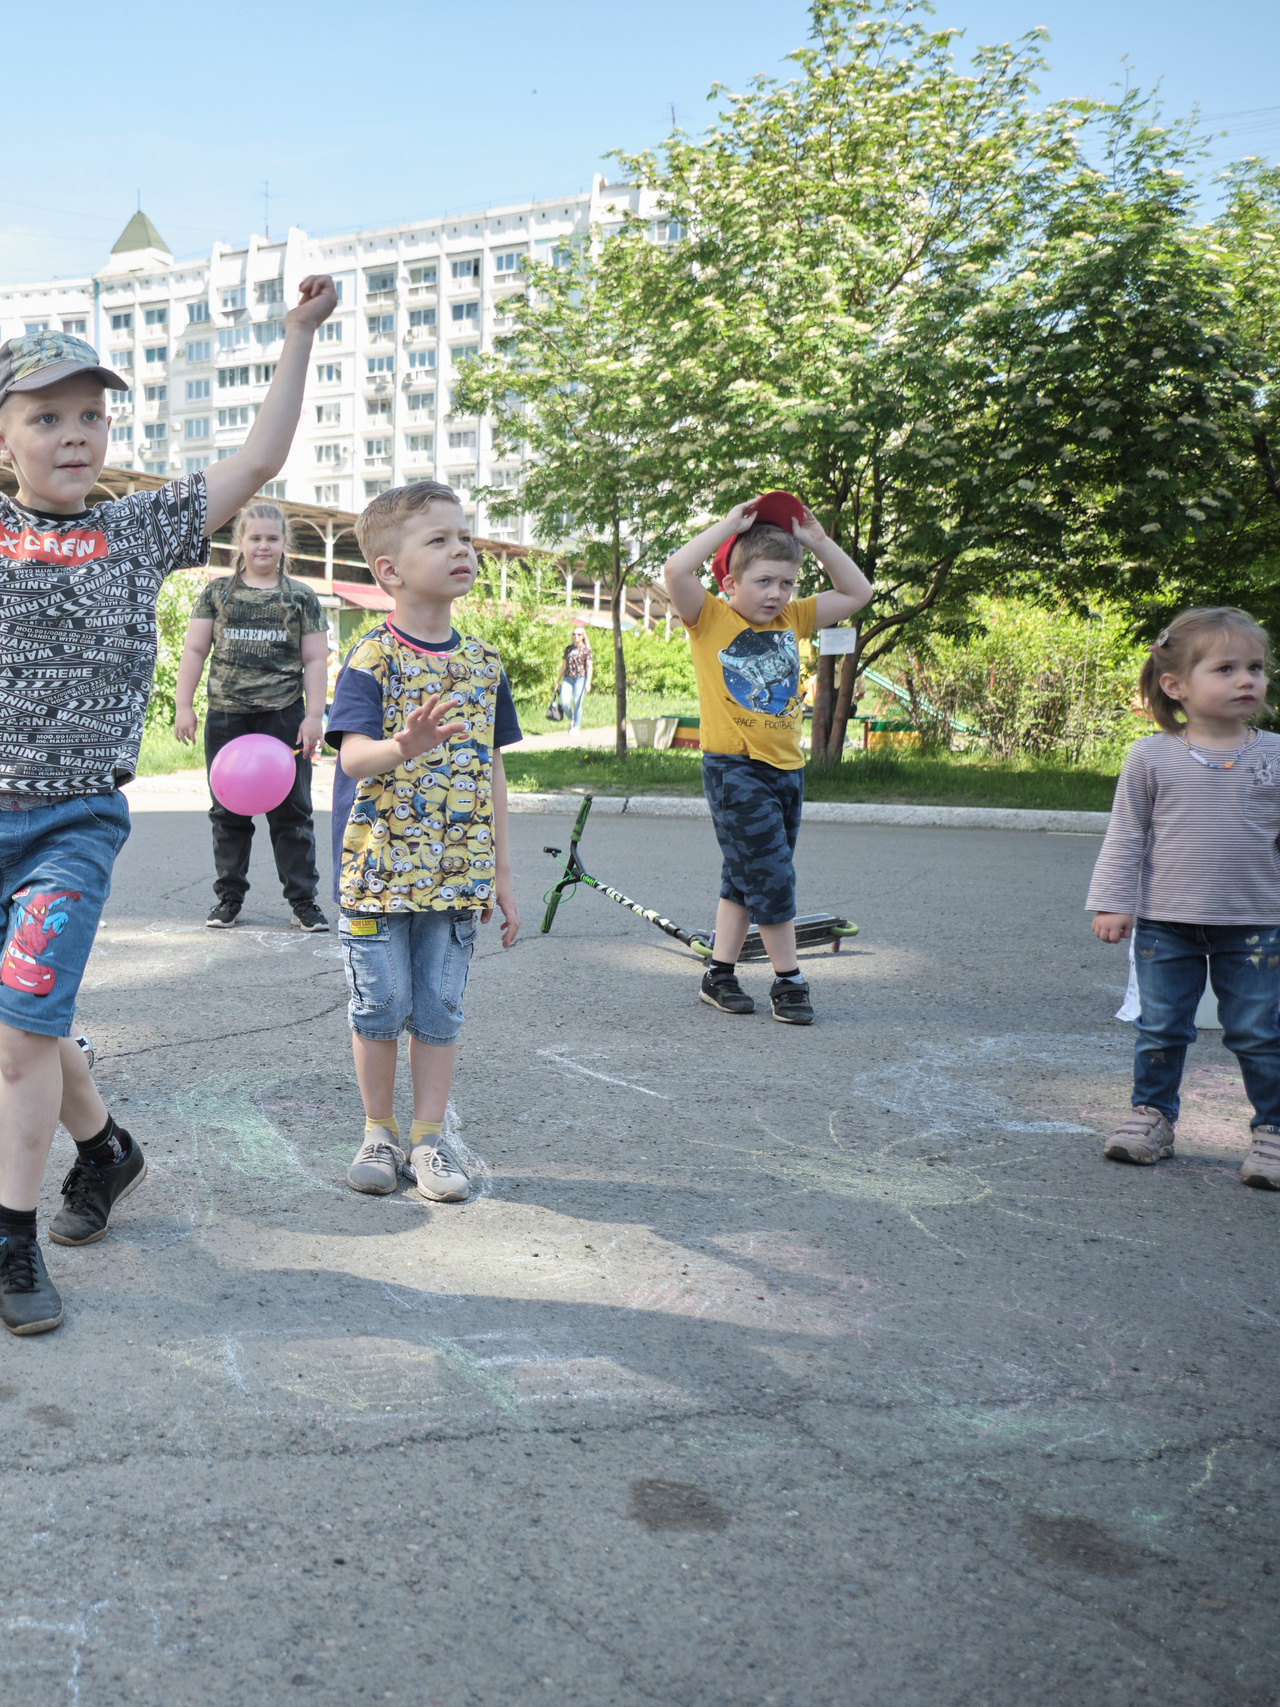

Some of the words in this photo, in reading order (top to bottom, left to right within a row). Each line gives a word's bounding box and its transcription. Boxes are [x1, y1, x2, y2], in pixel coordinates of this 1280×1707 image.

[223, 628, 287, 642] FREEDOM
[102, 636, 157, 653] XTREME
[20, 667, 93, 678] XTREME
[56, 710, 123, 736] WARNING
[733, 717, 757, 728] SPACE
